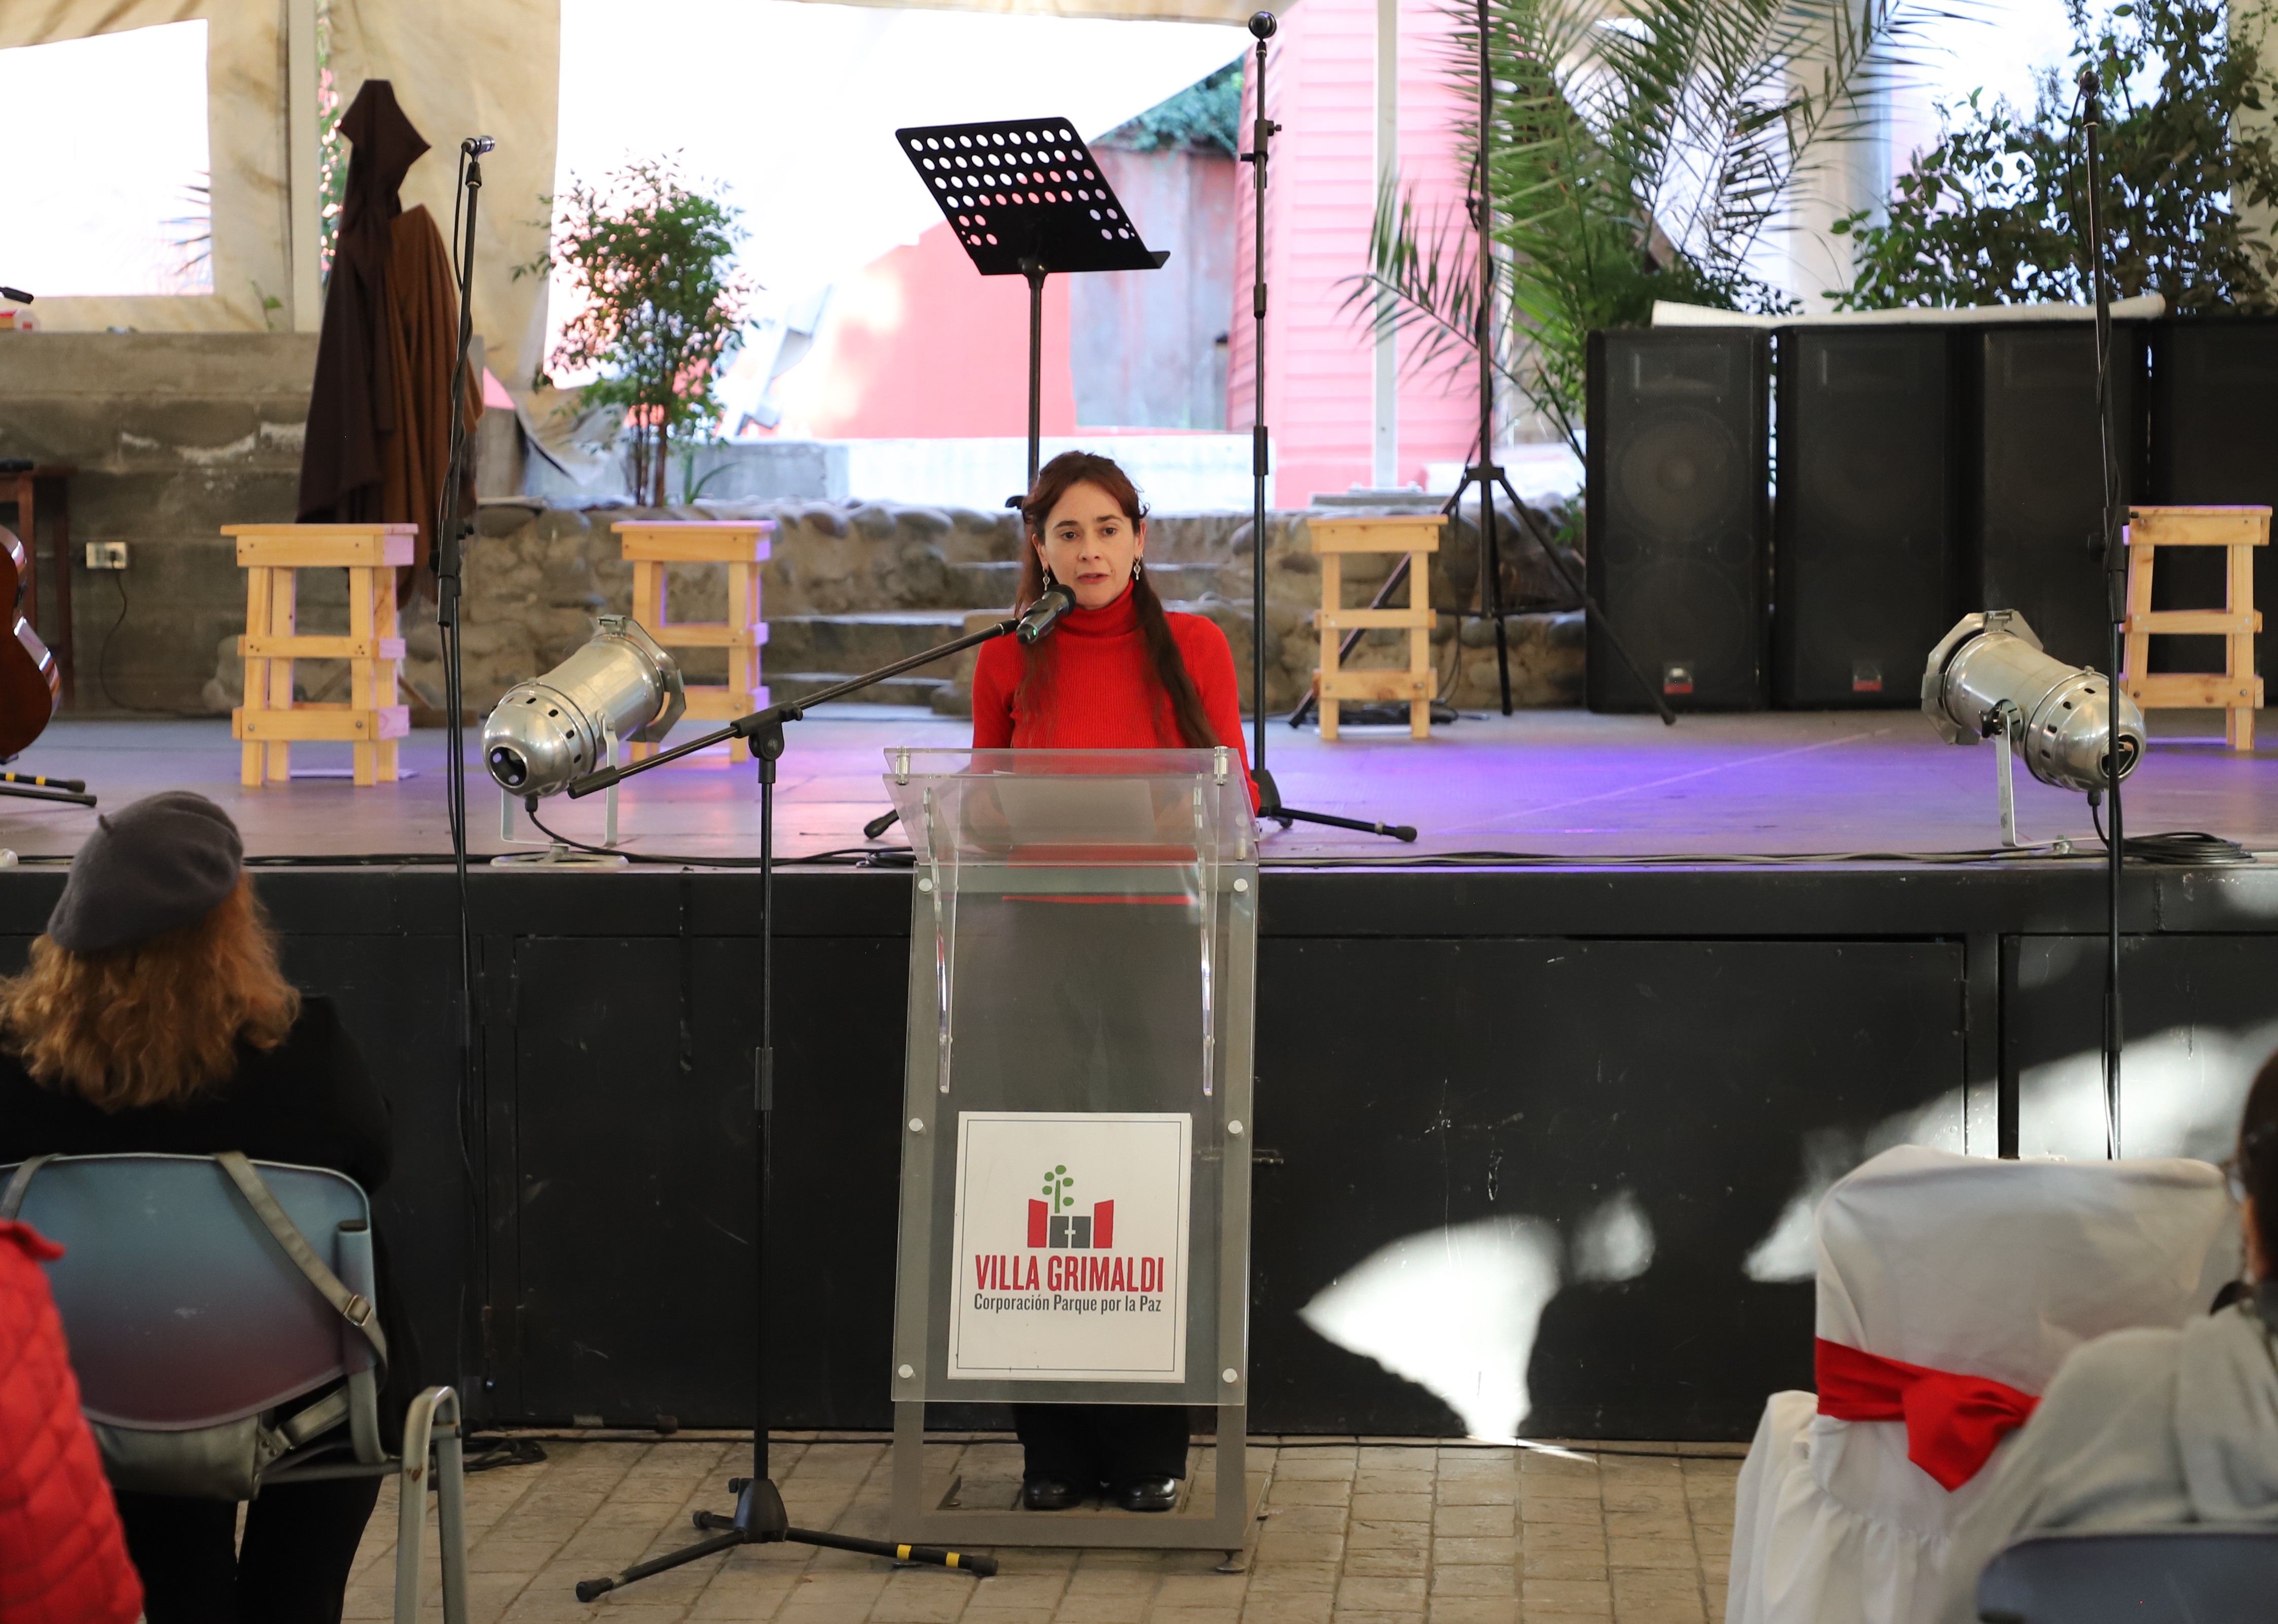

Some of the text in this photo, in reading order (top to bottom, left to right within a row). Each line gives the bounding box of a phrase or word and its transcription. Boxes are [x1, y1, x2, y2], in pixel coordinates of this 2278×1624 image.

[975, 1255, 1164, 1292] VILLA GRIMALDI
[974, 1293, 1161, 1315] Corporación Parque por la Paz
